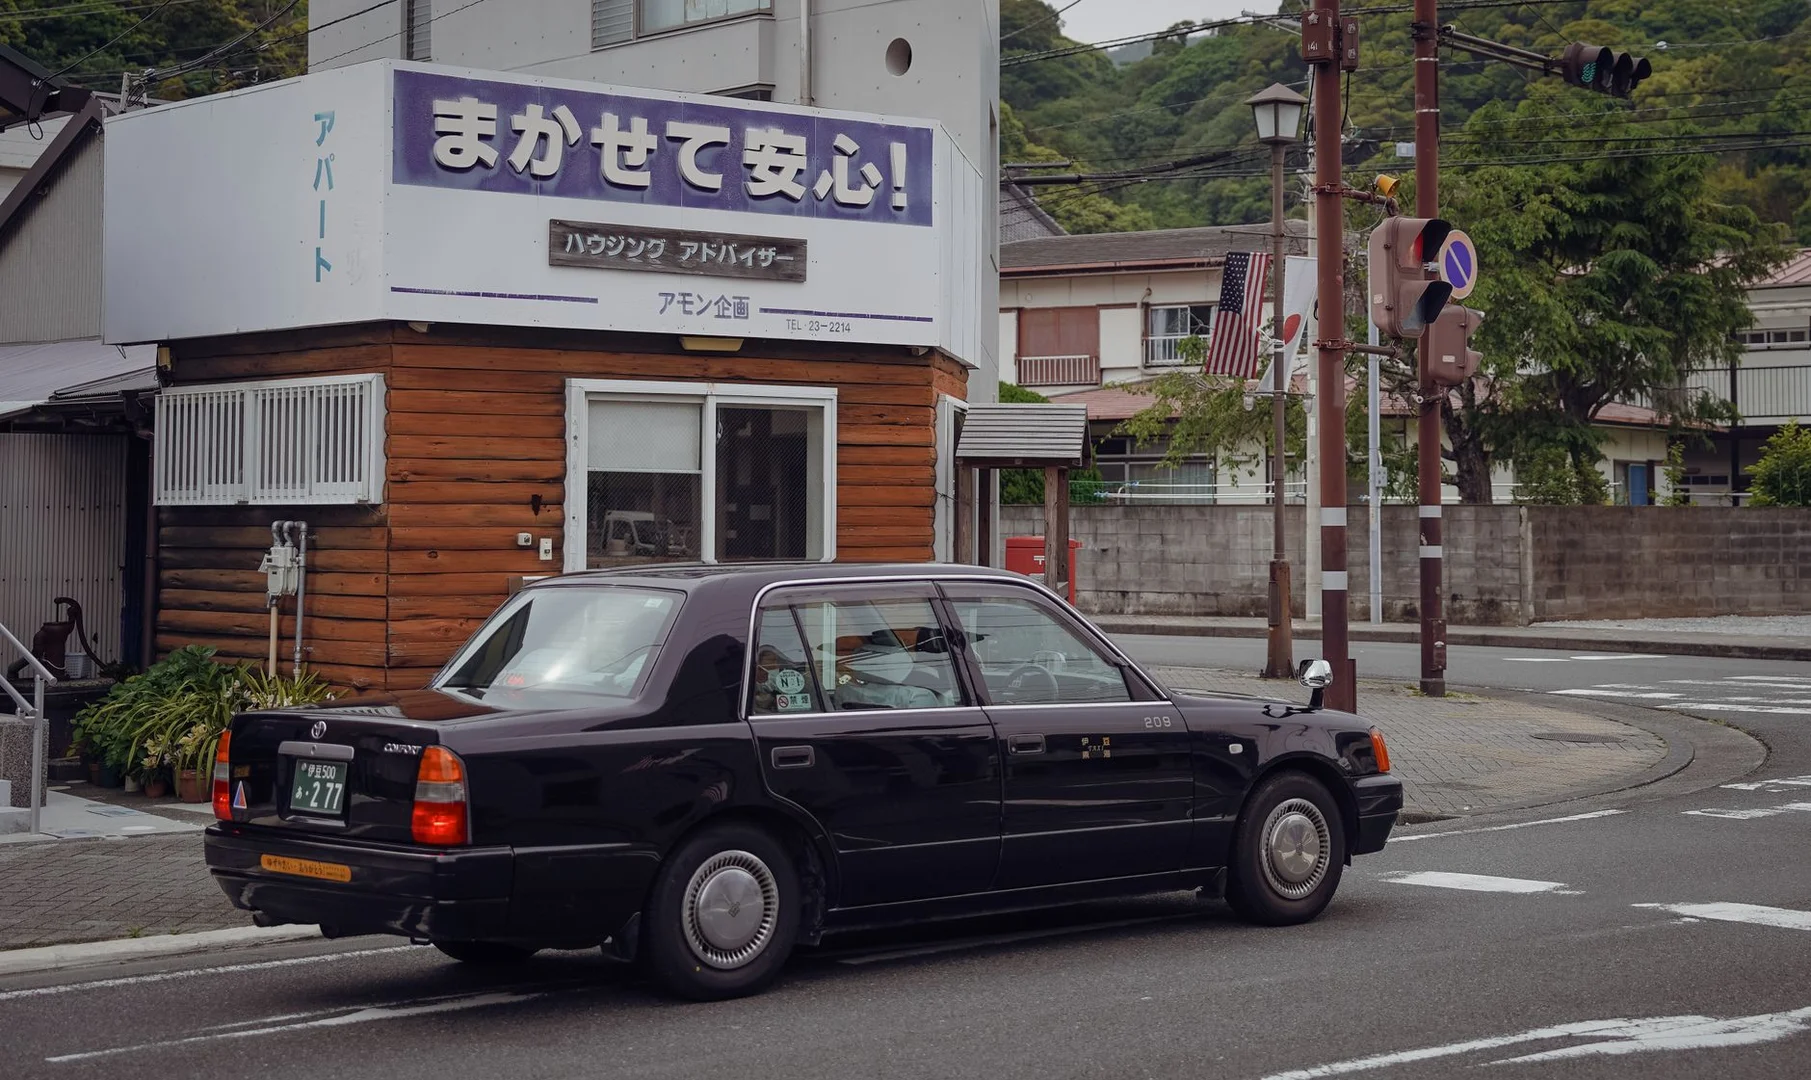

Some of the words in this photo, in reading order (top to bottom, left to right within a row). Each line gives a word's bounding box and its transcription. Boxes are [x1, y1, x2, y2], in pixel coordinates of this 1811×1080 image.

[431, 97, 908, 210] まかせて安心!
[313, 111, 336, 283] アパート
[565, 233, 666, 260] ハウジング
[679, 241, 794, 268] アドバイザー
[658, 292, 750, 320] アモン企画
[1144, 716, 1171, 728] 209
